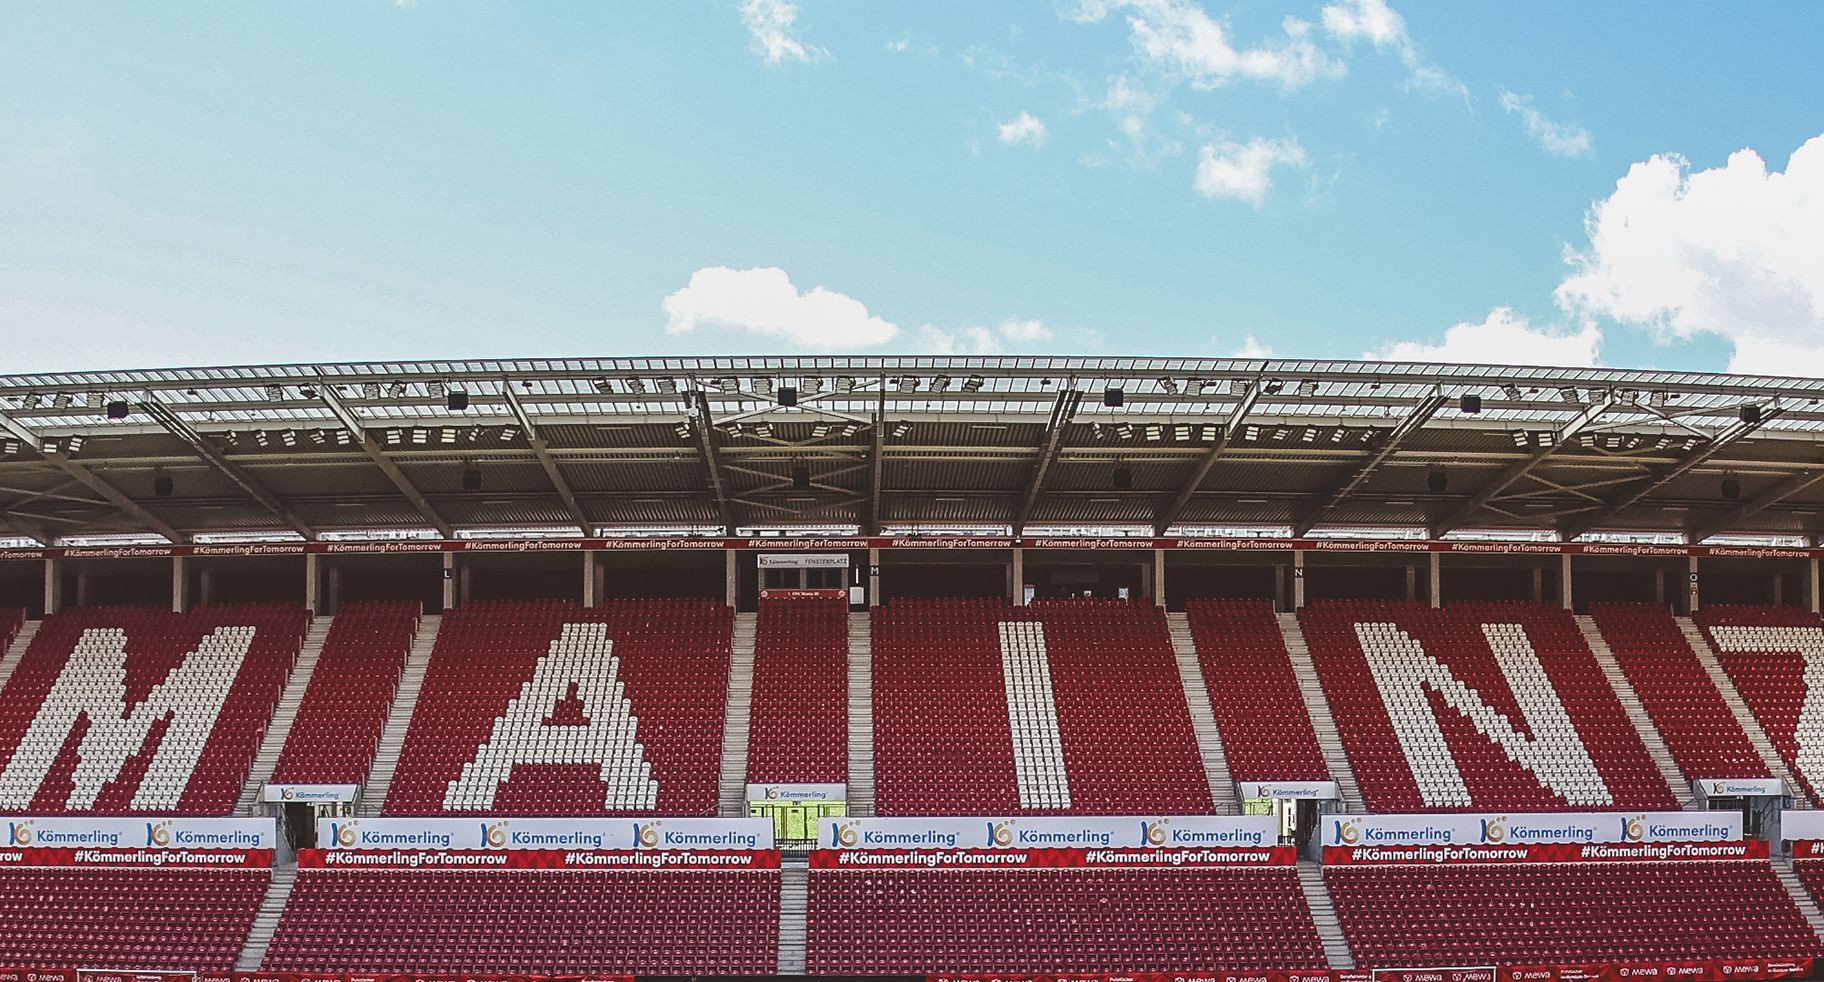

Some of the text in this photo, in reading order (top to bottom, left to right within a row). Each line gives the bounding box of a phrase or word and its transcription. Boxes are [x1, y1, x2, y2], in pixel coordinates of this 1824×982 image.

[445, 569, 451, 577] L
[871, 567, 879, 575] M
[1295, 568, 1303, 576] N
[37, 829, 118, 845] Kömmerling
[176, 830, 260, 846] Kömmerling
[362, 830, 450, 846] Kömmerling
[512, 830, 602, 847] Kömmerling
[665, 830, 756, 847] Kömmerling
[864, 830, 956, 846] Kömmerling
[1019, 829, 1110, 846] Kömmerling
[1172, 828, 1262, 845] Kömmerling
[1365, 826, 1451, 842] Kömmerling
[1510, 825, 1593, 841] Kömmerling
[1649, 823, 1729, 839] Kömmerling
[74, 850, 245, 866] #KömmerlingForTomorrow
[326, 851, 507, 867] #KömmerlingForTomorrow
[565, 851, 752, 867] #KömmerlingForTomorrow
[838, 850, 1028, 867] #KömmerlingForTomorrow
[1086, 850, 1270, 866] #KömmerlingForTomorrow
[1352, 847, 1528, 863] #KömmerlingForTomorrow
[1581, 844, 1746, 860] #KömmerlingForTomorrow
